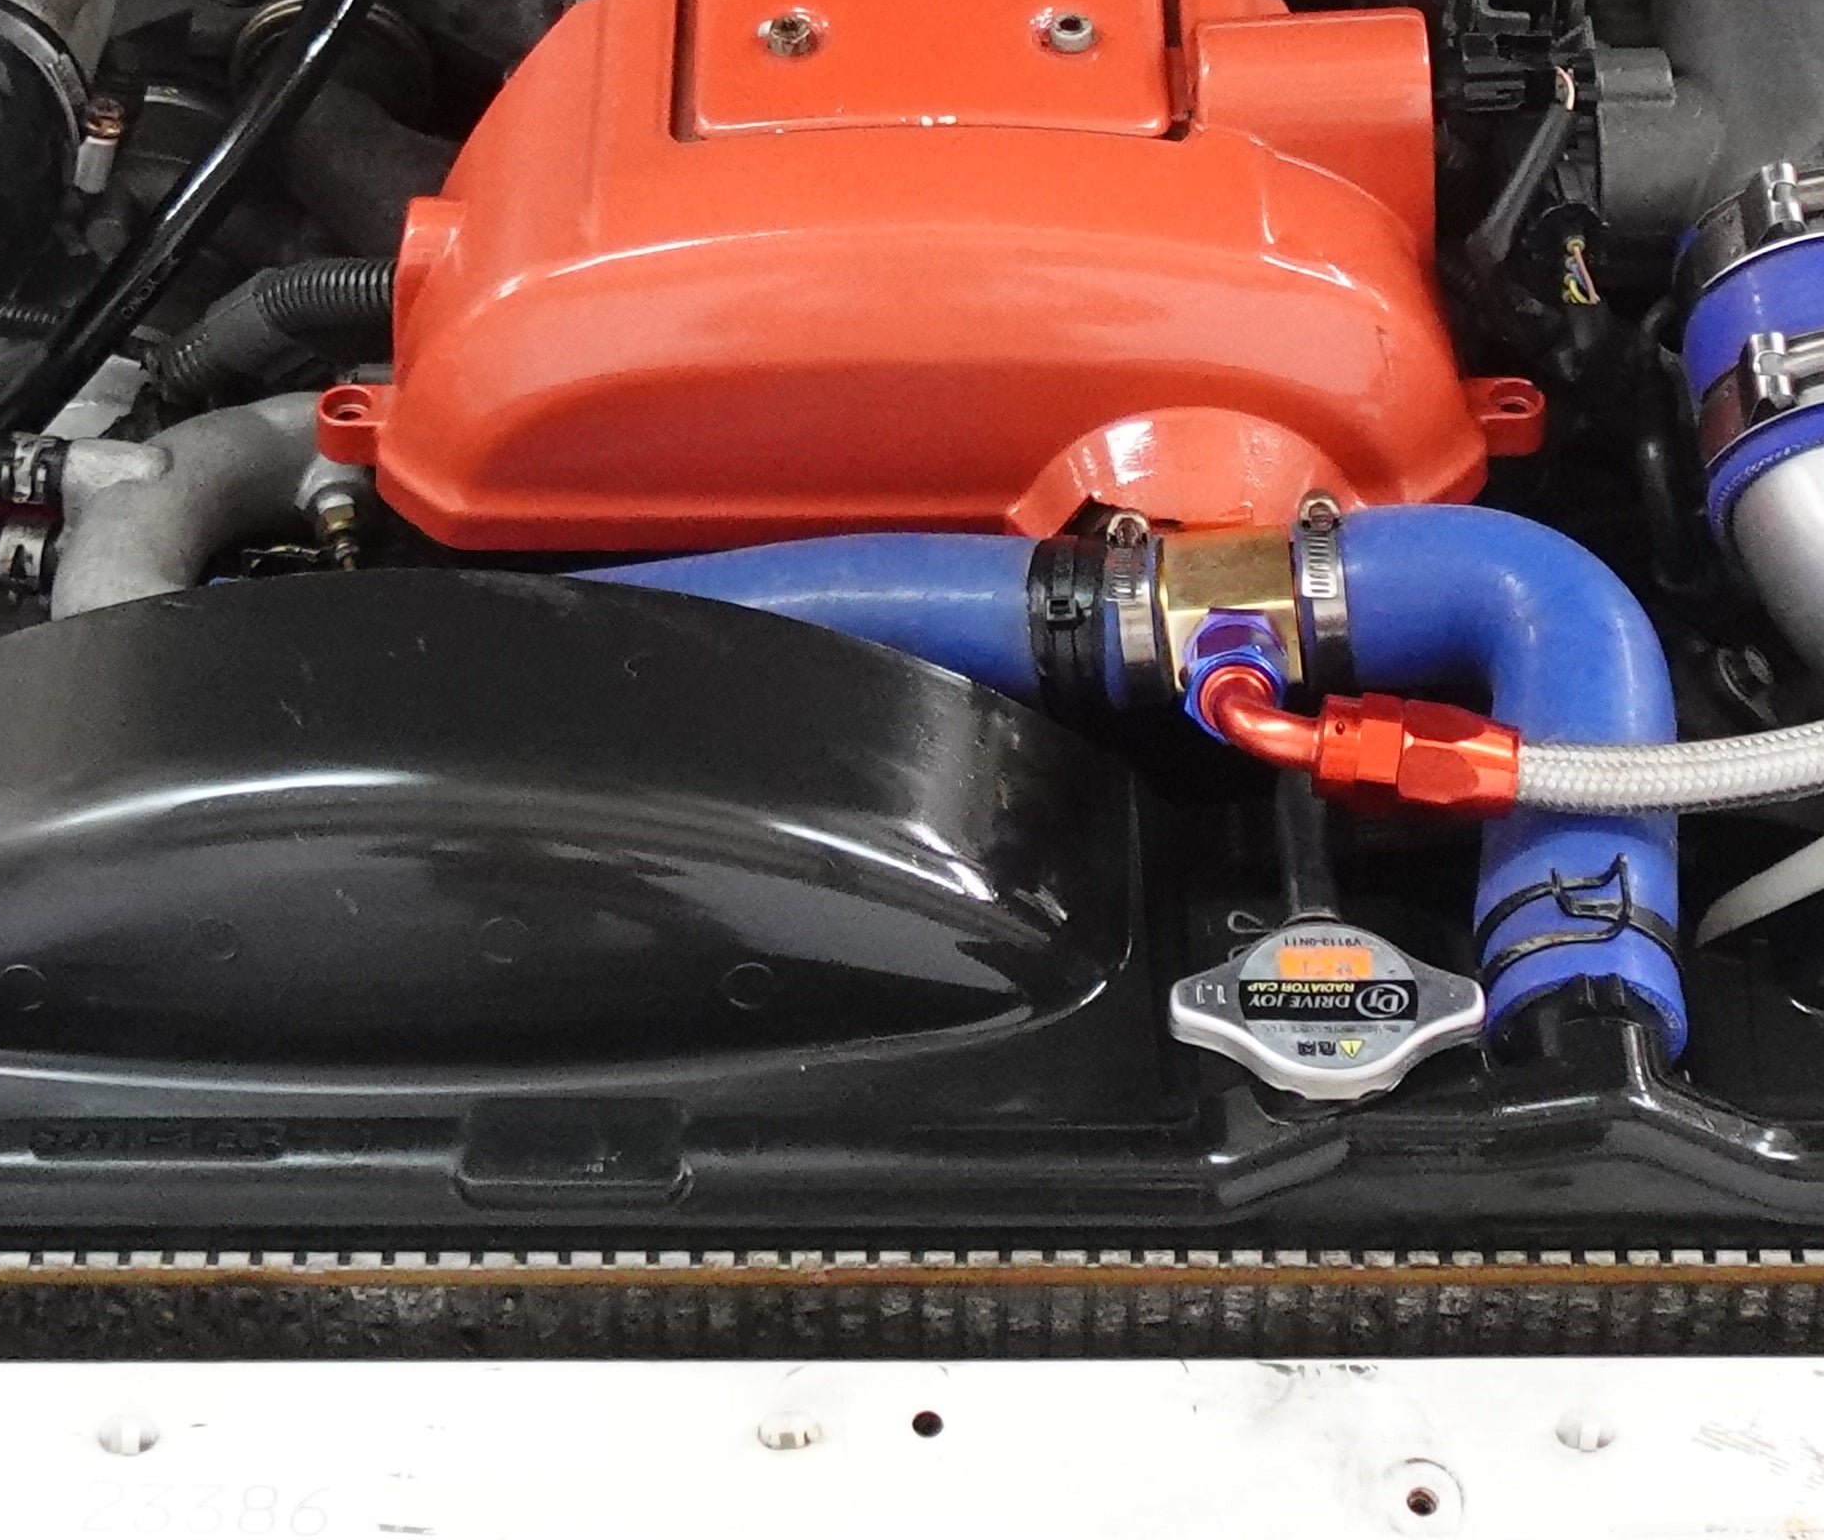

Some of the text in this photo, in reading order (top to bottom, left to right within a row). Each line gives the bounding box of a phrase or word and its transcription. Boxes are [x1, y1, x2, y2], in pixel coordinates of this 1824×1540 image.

[1246, 981, 1356, 993] RADIATOR CAP
[1248, 991, 1351, 1009] DRIVE JOY
[79, 1478, 332, 1538] 23386
